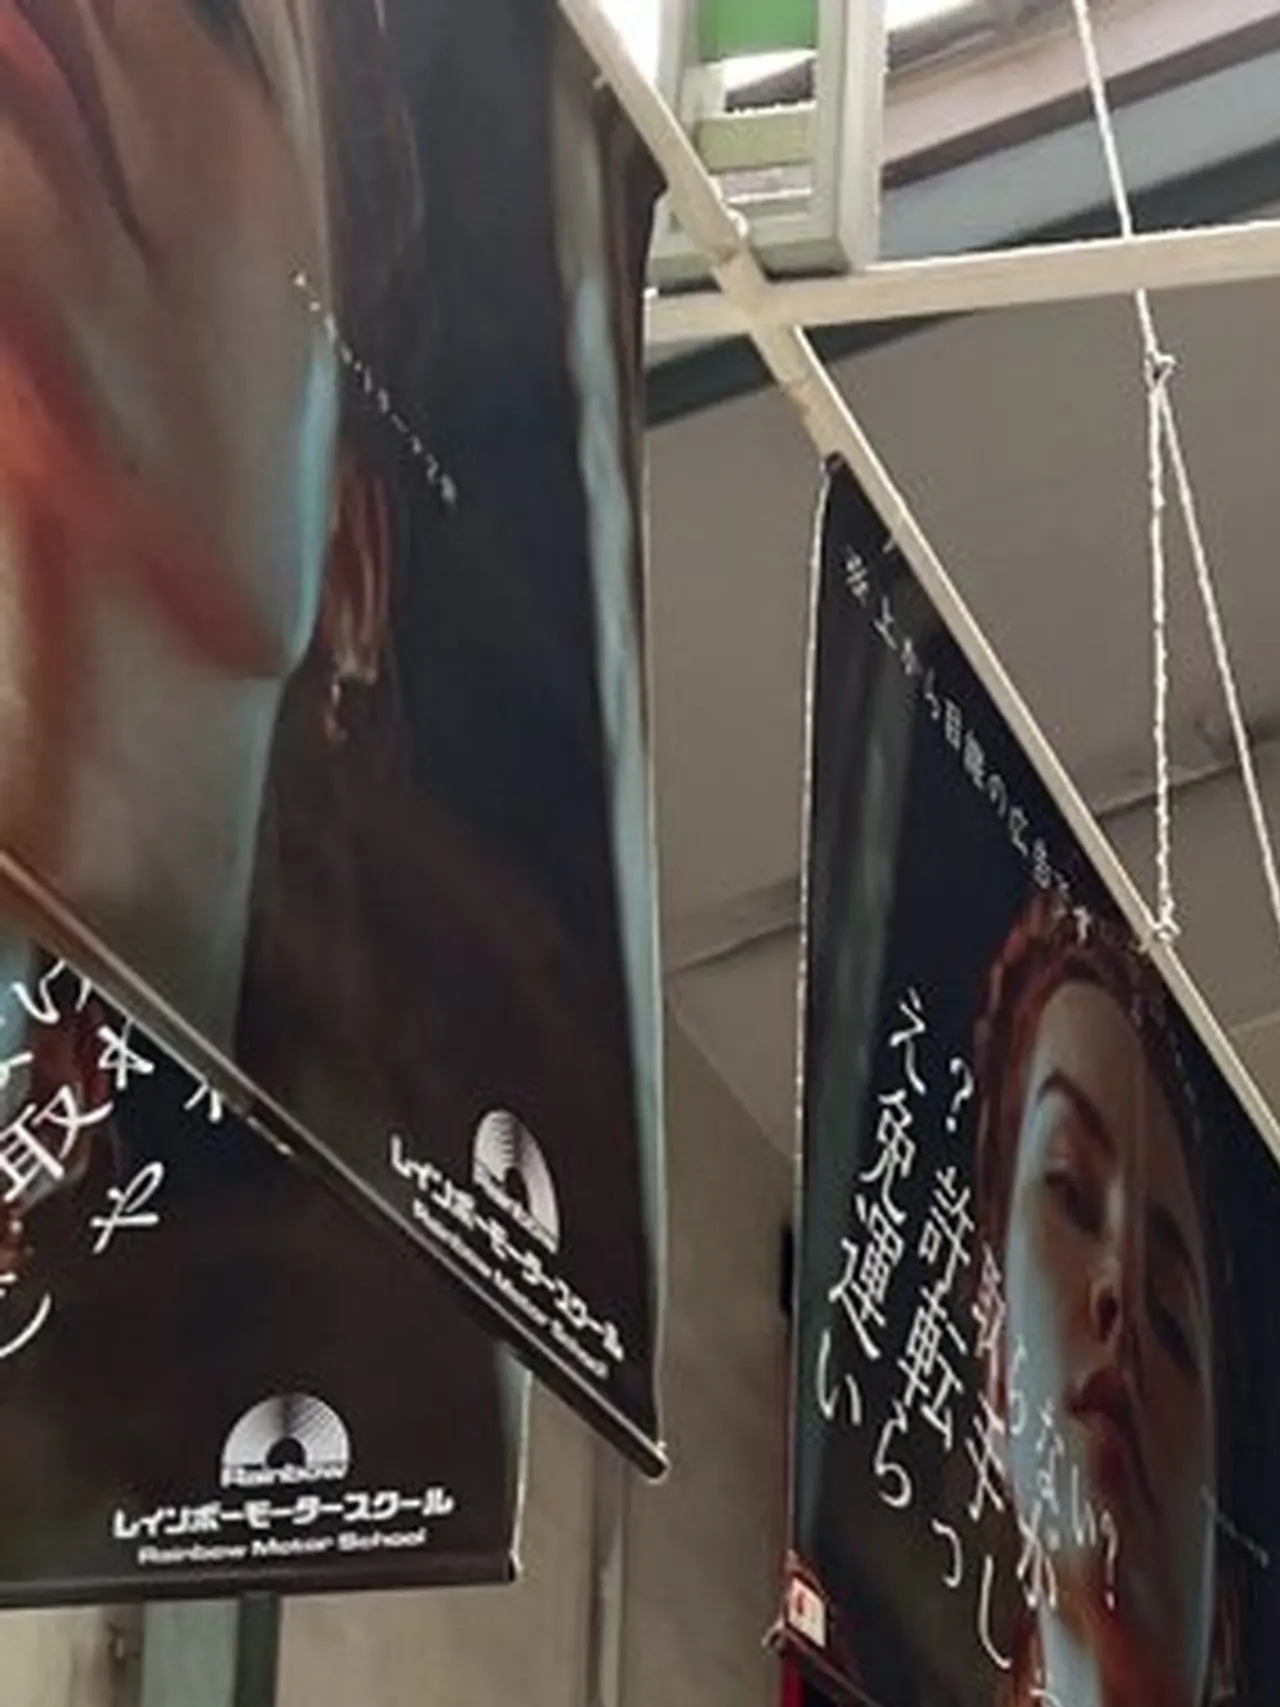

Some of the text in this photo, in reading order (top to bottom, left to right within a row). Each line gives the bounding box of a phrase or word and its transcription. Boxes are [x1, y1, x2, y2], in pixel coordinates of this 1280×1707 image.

[113, 1488, 455, 1539] レインボーモータースクール
